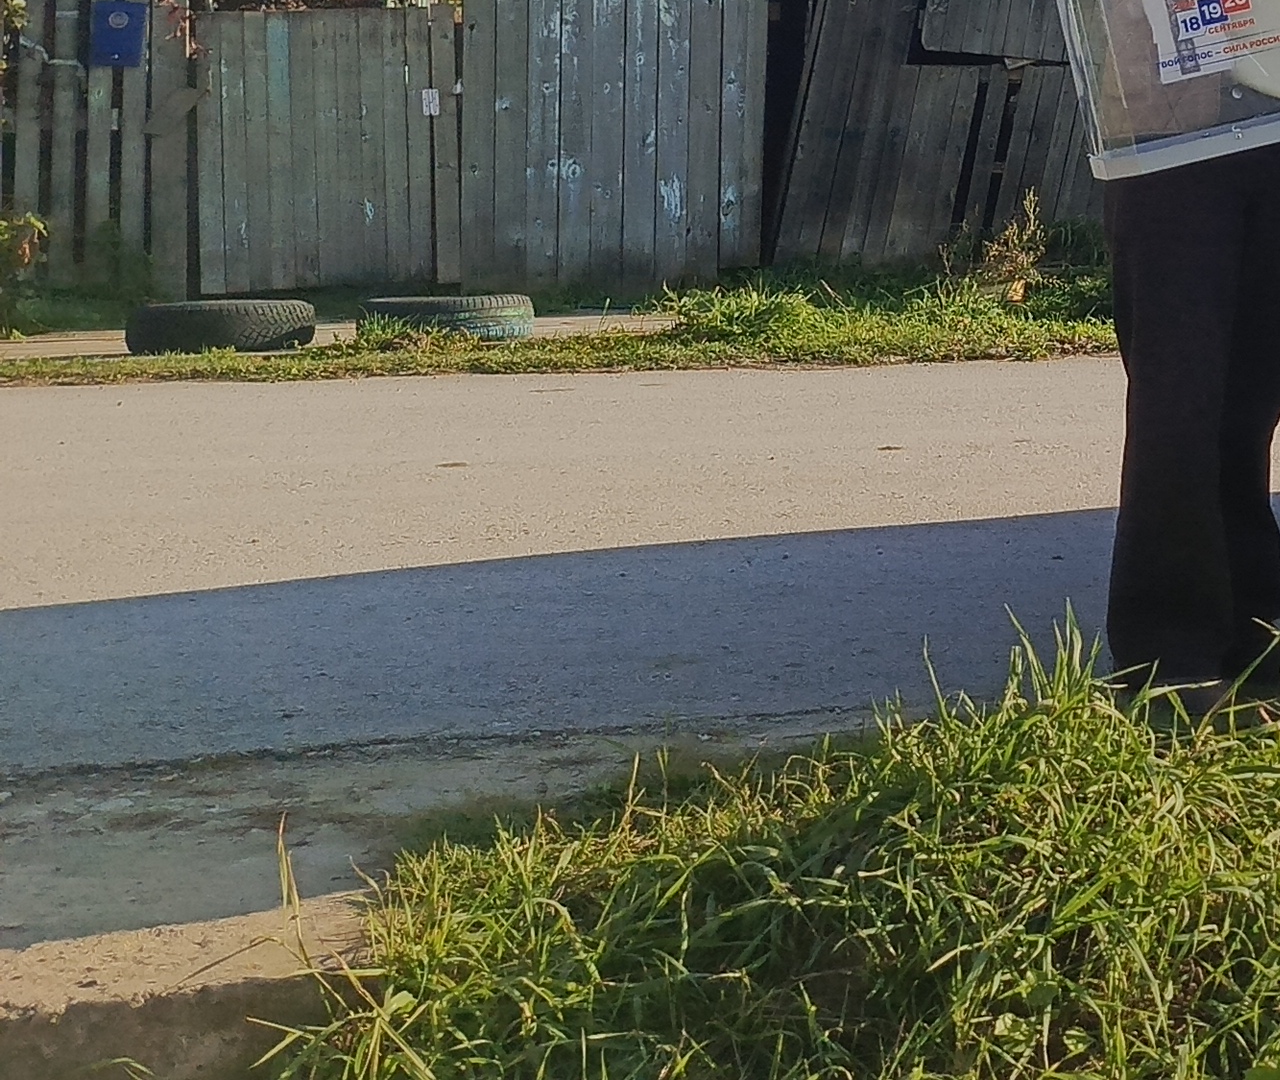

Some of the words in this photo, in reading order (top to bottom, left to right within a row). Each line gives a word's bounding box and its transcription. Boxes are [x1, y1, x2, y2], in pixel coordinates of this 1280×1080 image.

[1180, 16, 1200, 33] 18
[1201, 3, 1222, 20] 19
[1208, 18, 1256, 34] СЕНТЯБРЯ
[1181, 50, 1214, 64] ГОЛОС
[1223, 43, 1248, 54] СИЛА
